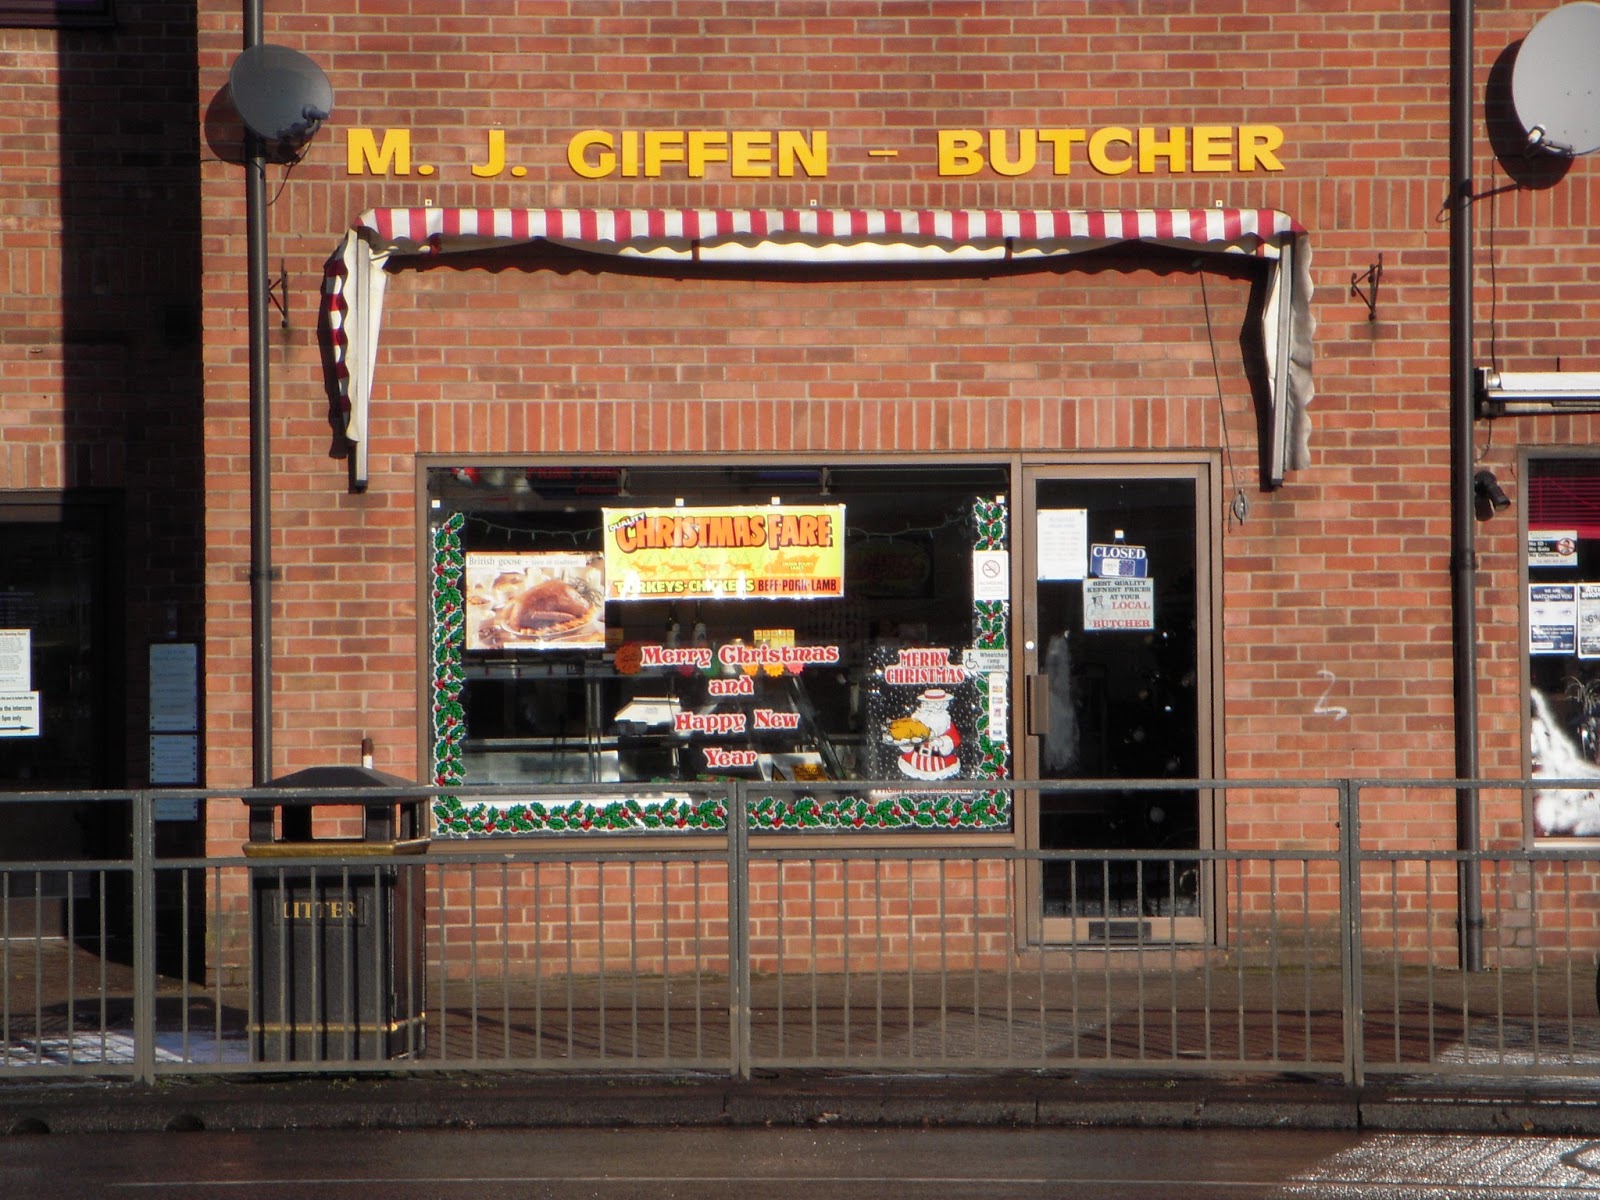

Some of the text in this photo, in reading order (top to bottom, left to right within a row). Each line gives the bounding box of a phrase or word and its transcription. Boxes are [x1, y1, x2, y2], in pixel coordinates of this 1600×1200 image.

[346, 127, 435, 176] M.
[471, 130, 527, 178] J.
[567, 129, 828, 178] GIFFEN
[937, 125, 1286, 176] BUTCHER
[608, 513, 645, 531] QUALITY
[615, 513, 833, 554] CHRISTMAS FARE
[469, 557, 495, 565] British
[498, 558, 522, 566] goose
[1093, 546, 1146, 560] CLOSED
[688, 578, 756, 593] CHCKES
[1112, 601, 1151, 610] LOCAL
[1092, 619, 1151, 628] BUTCHER
[641, 644, 839, 668] Merry Christmas
[899, 650, 950, 668] MERRY
[885, 667, 965, 685] CHRISTMAS
[708, 675, 754, 696] and
[12, 714, 22, 723] only
[674, 708, 801, 734] Happy New
[703, 747, 758, 768] Year
[282, 901, 358, 919] LITTER
